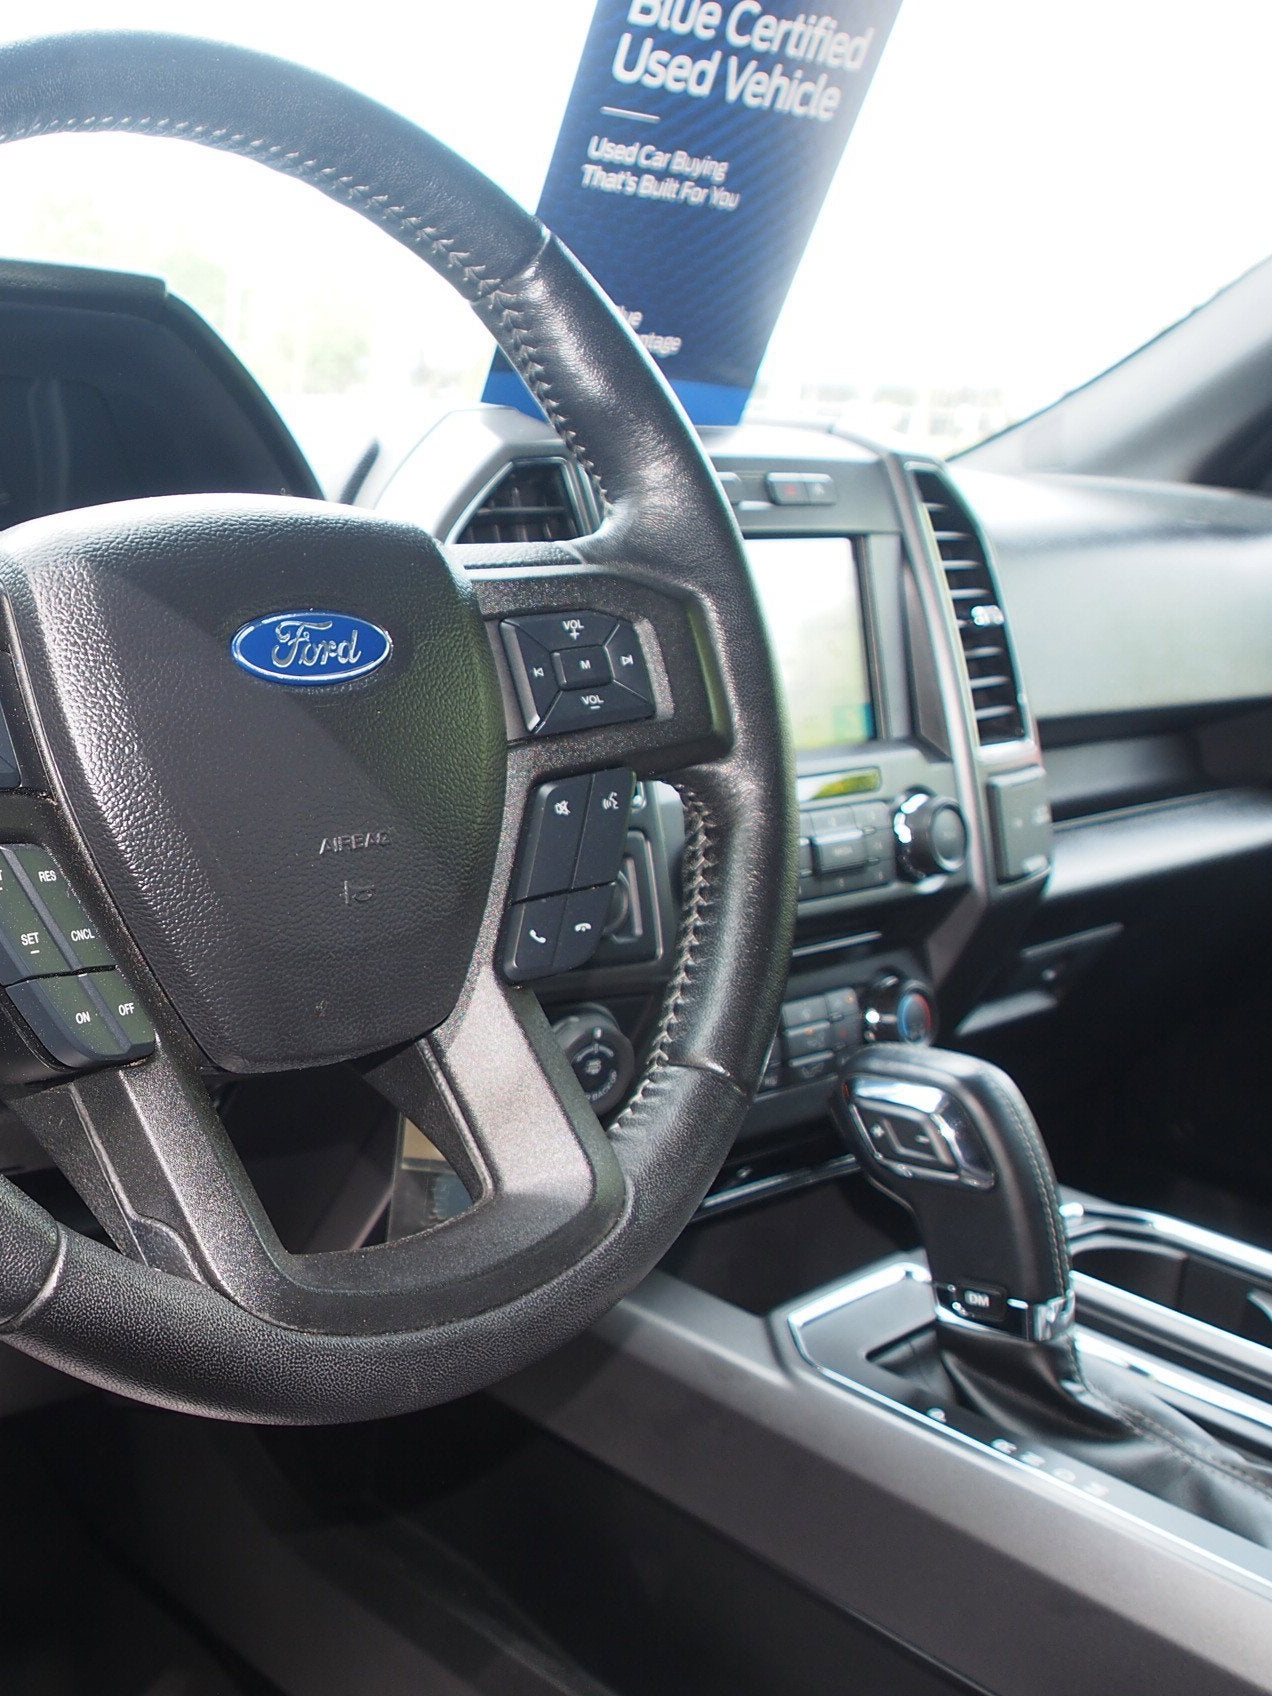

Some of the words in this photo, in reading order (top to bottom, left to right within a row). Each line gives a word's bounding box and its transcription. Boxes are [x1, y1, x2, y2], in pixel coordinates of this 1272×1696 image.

[627, 0, 723, 41] Blue
[725, 0, 875, 71] Certified
[612, 32, 723, 98] Used
[725, 55, 843, 121] Vehicle
[587, 135, 642, 166] Used
[637, 144, 671, 171] Car
[669, 150, 729, 184] Buying
[581, 164, 638, 196] That's
[638, 174, 679, 202] Built
[678, 180, 709, 206] For
[709, 185, 741, 212] You
[562, 619, 585, 631] VOL
[271, 620, 362, 668] Ford
[580, 659, 591, 671] M
[582, 694, 604, 705] VOL
[38, 869, 57, 882] RES
[21, 932, 39, 946] SET
[70, 930, 95, 942] CNCL
[118, 1002, 135, 1016] OFF
[75, 1011, 91, 1025] ON
